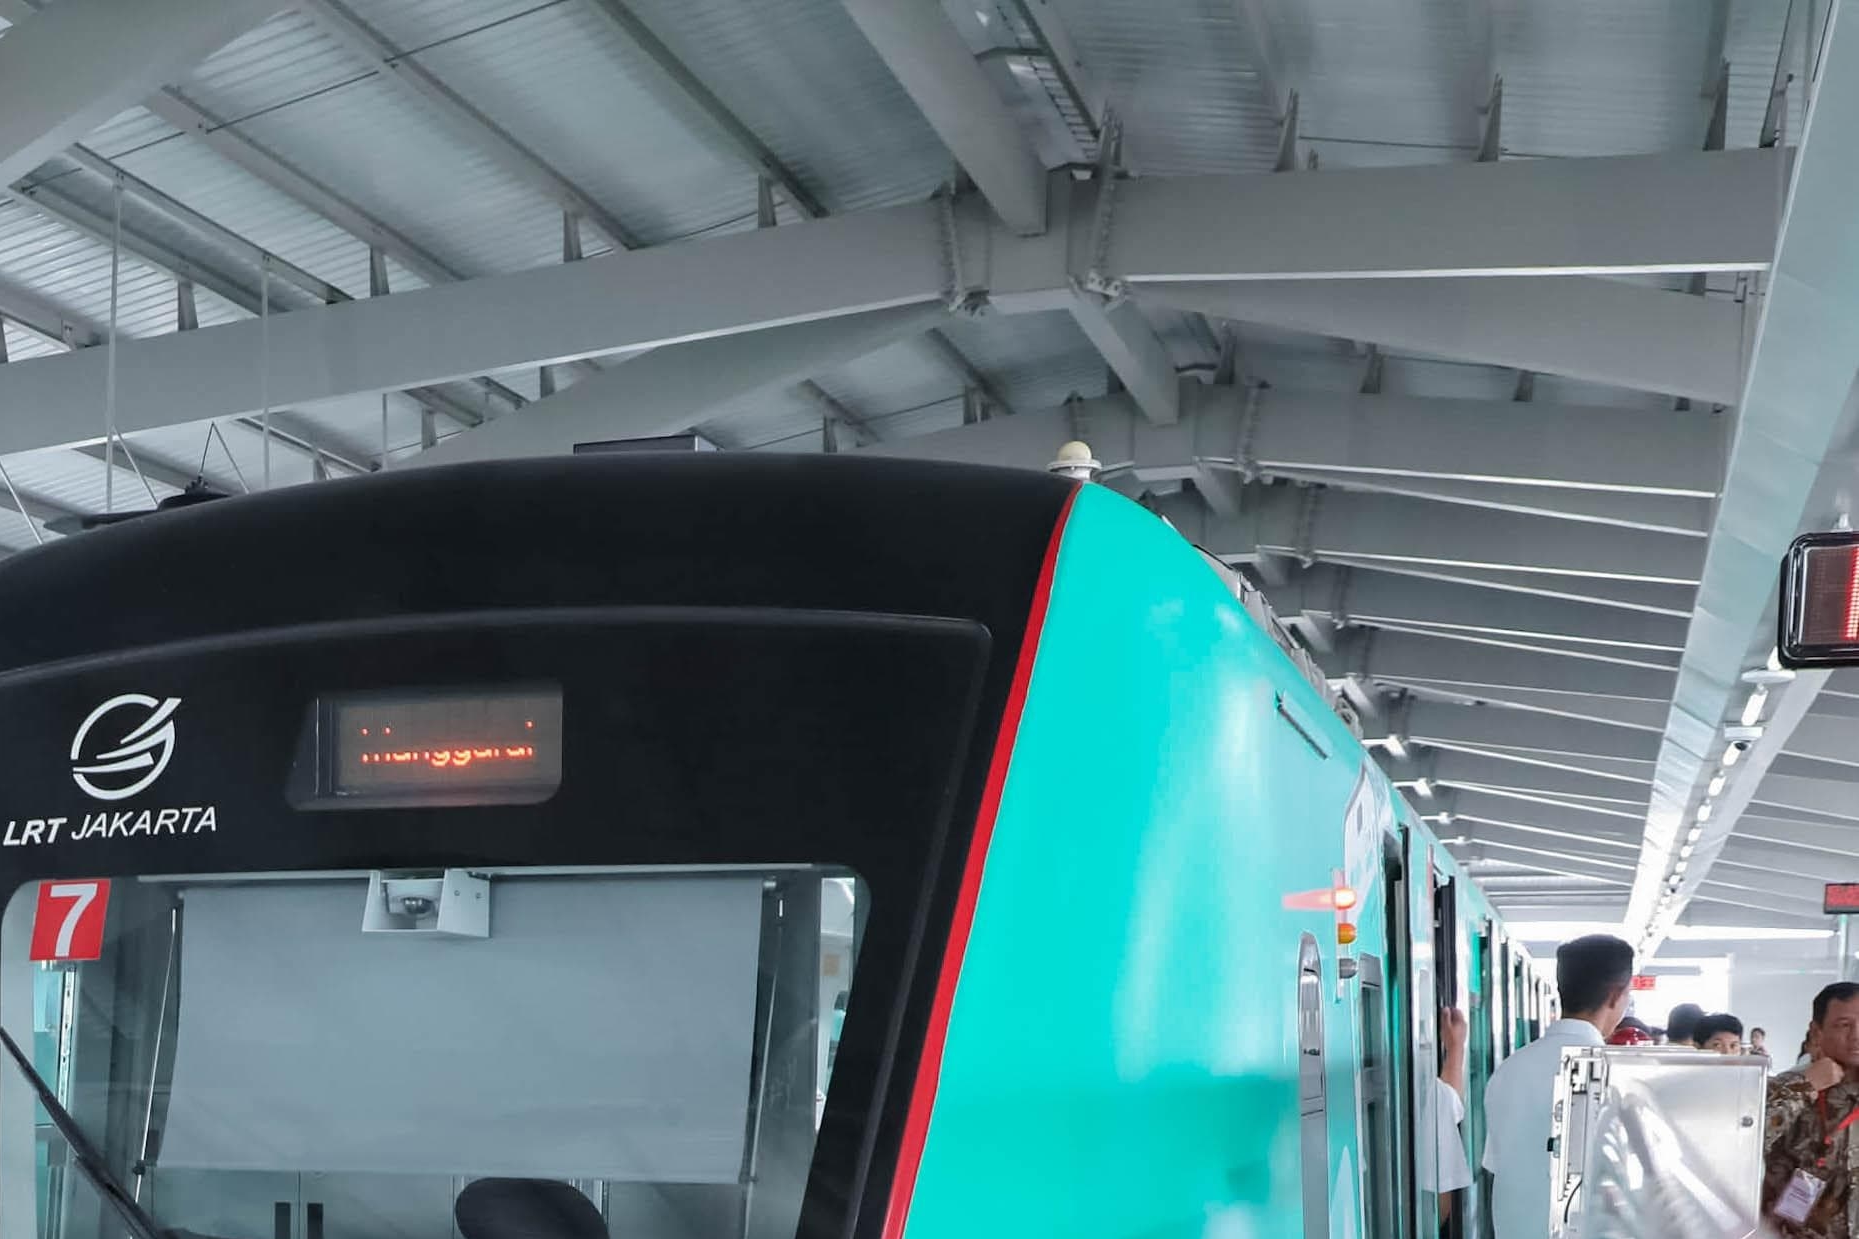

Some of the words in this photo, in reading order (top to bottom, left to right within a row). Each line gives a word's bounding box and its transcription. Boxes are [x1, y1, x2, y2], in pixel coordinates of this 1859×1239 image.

[3, 817, 67, 846] LRT
[71, 806, 217, 840] JAKARTA
[50, 883, 98, 957] 7
